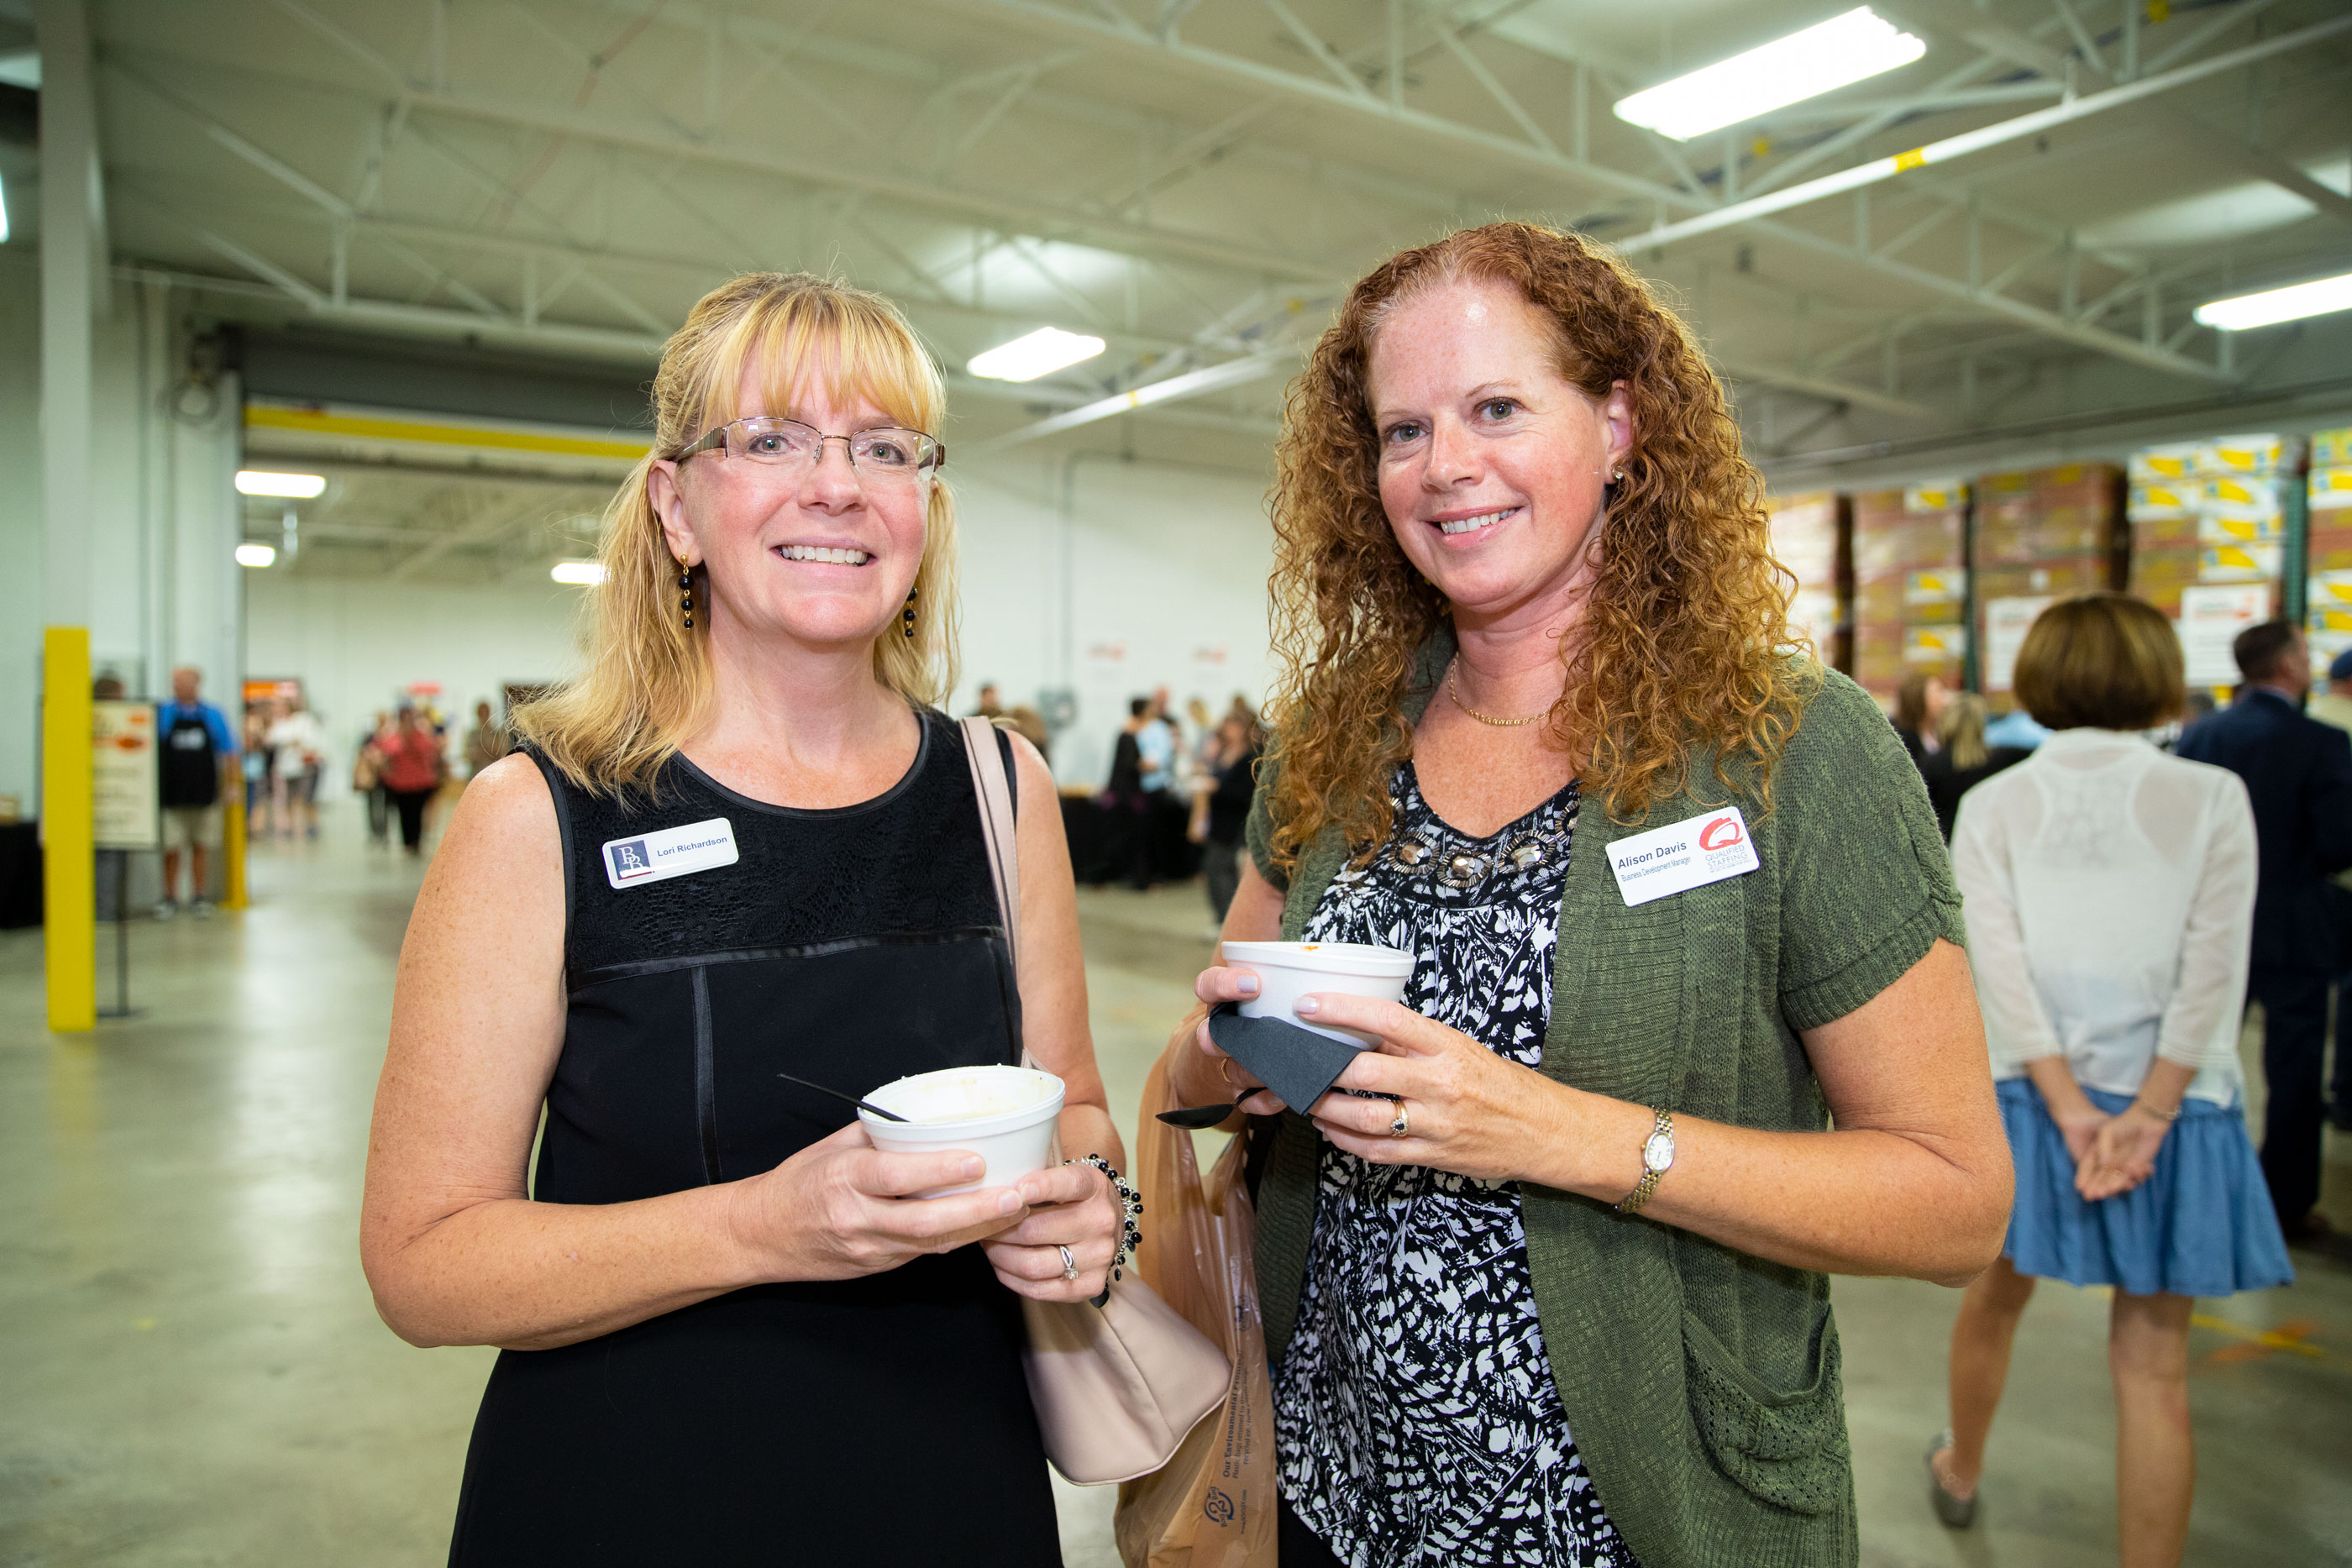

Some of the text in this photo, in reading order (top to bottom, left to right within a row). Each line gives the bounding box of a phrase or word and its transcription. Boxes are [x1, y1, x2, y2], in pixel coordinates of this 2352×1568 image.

[657, 836, 727, 857] Lori Richardson
[1618, 842, 1687, 869] Alison Davis
[1705, 844, 1745, 861] QUALIFIED
[1620, 857, 1691, 883] Business Development Manager
[1708, 852, 1748, 869] STAFFING
[1224, 1392, 1237, 1457] Environmental
[1208, 1500, 1228, 1513] 2
